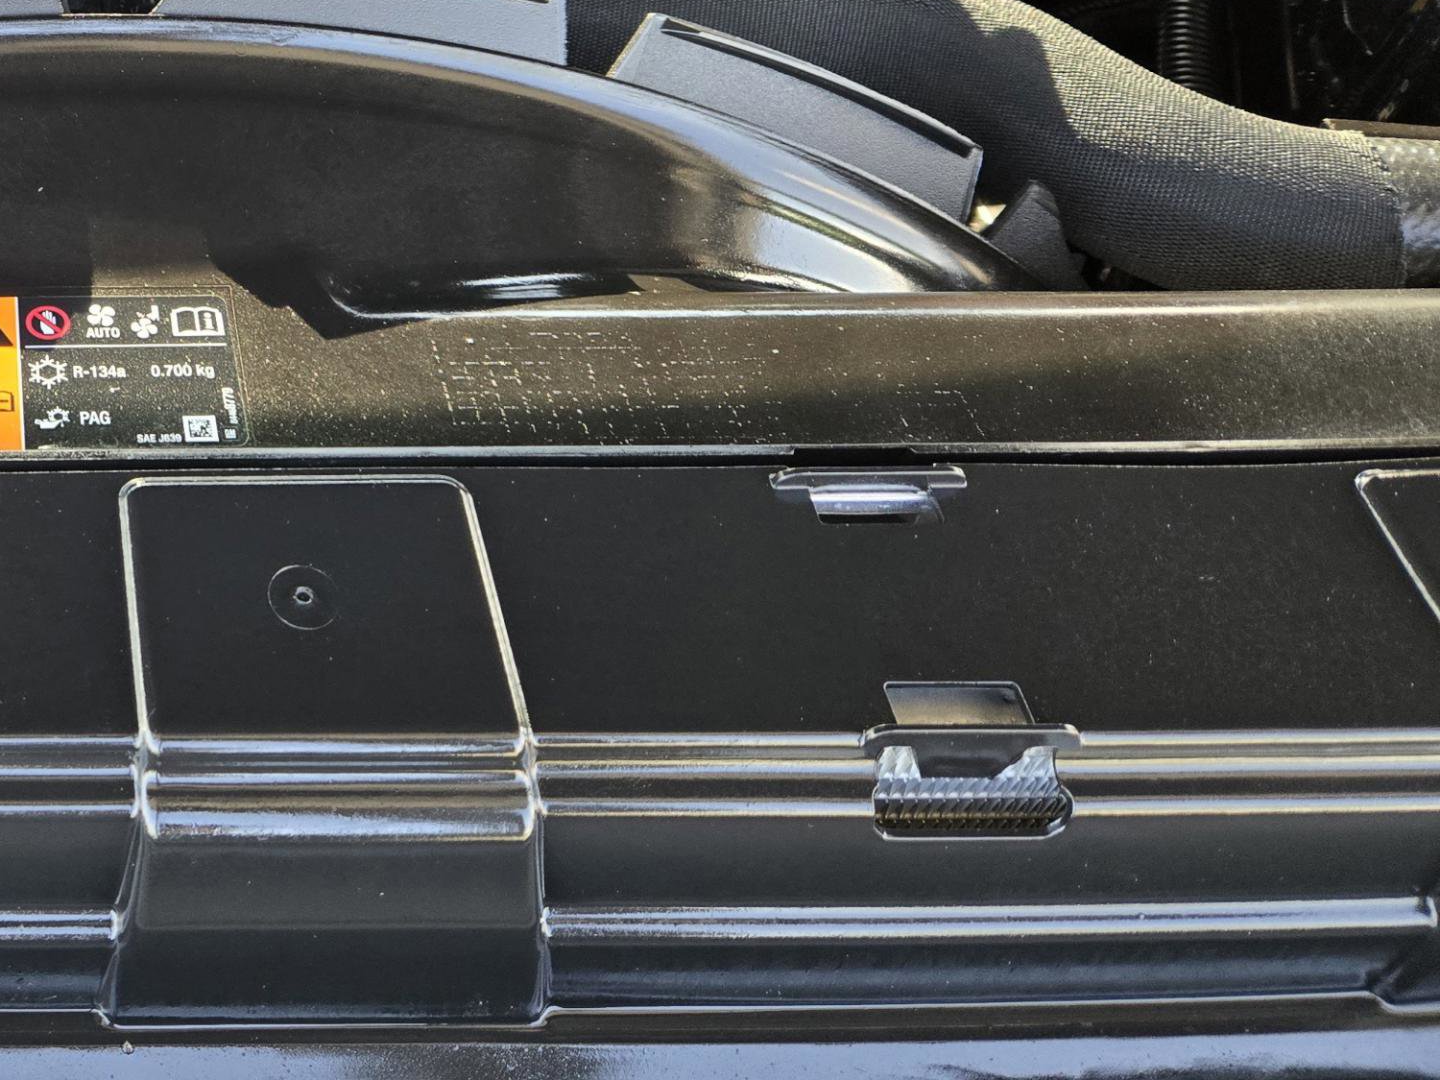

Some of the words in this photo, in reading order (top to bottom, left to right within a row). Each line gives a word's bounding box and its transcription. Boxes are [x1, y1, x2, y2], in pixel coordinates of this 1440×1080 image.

[86, 327, 121, 339] AUTO
[72, 365, 126, 379] R-134a
[150, 364, 192, 378] 0.700
[195, 364, 215, 380] kg
[79, 411, 112, 426] PAG
[136, 433, 157, 444] SAE
[158, 432, 182, 443] J639
